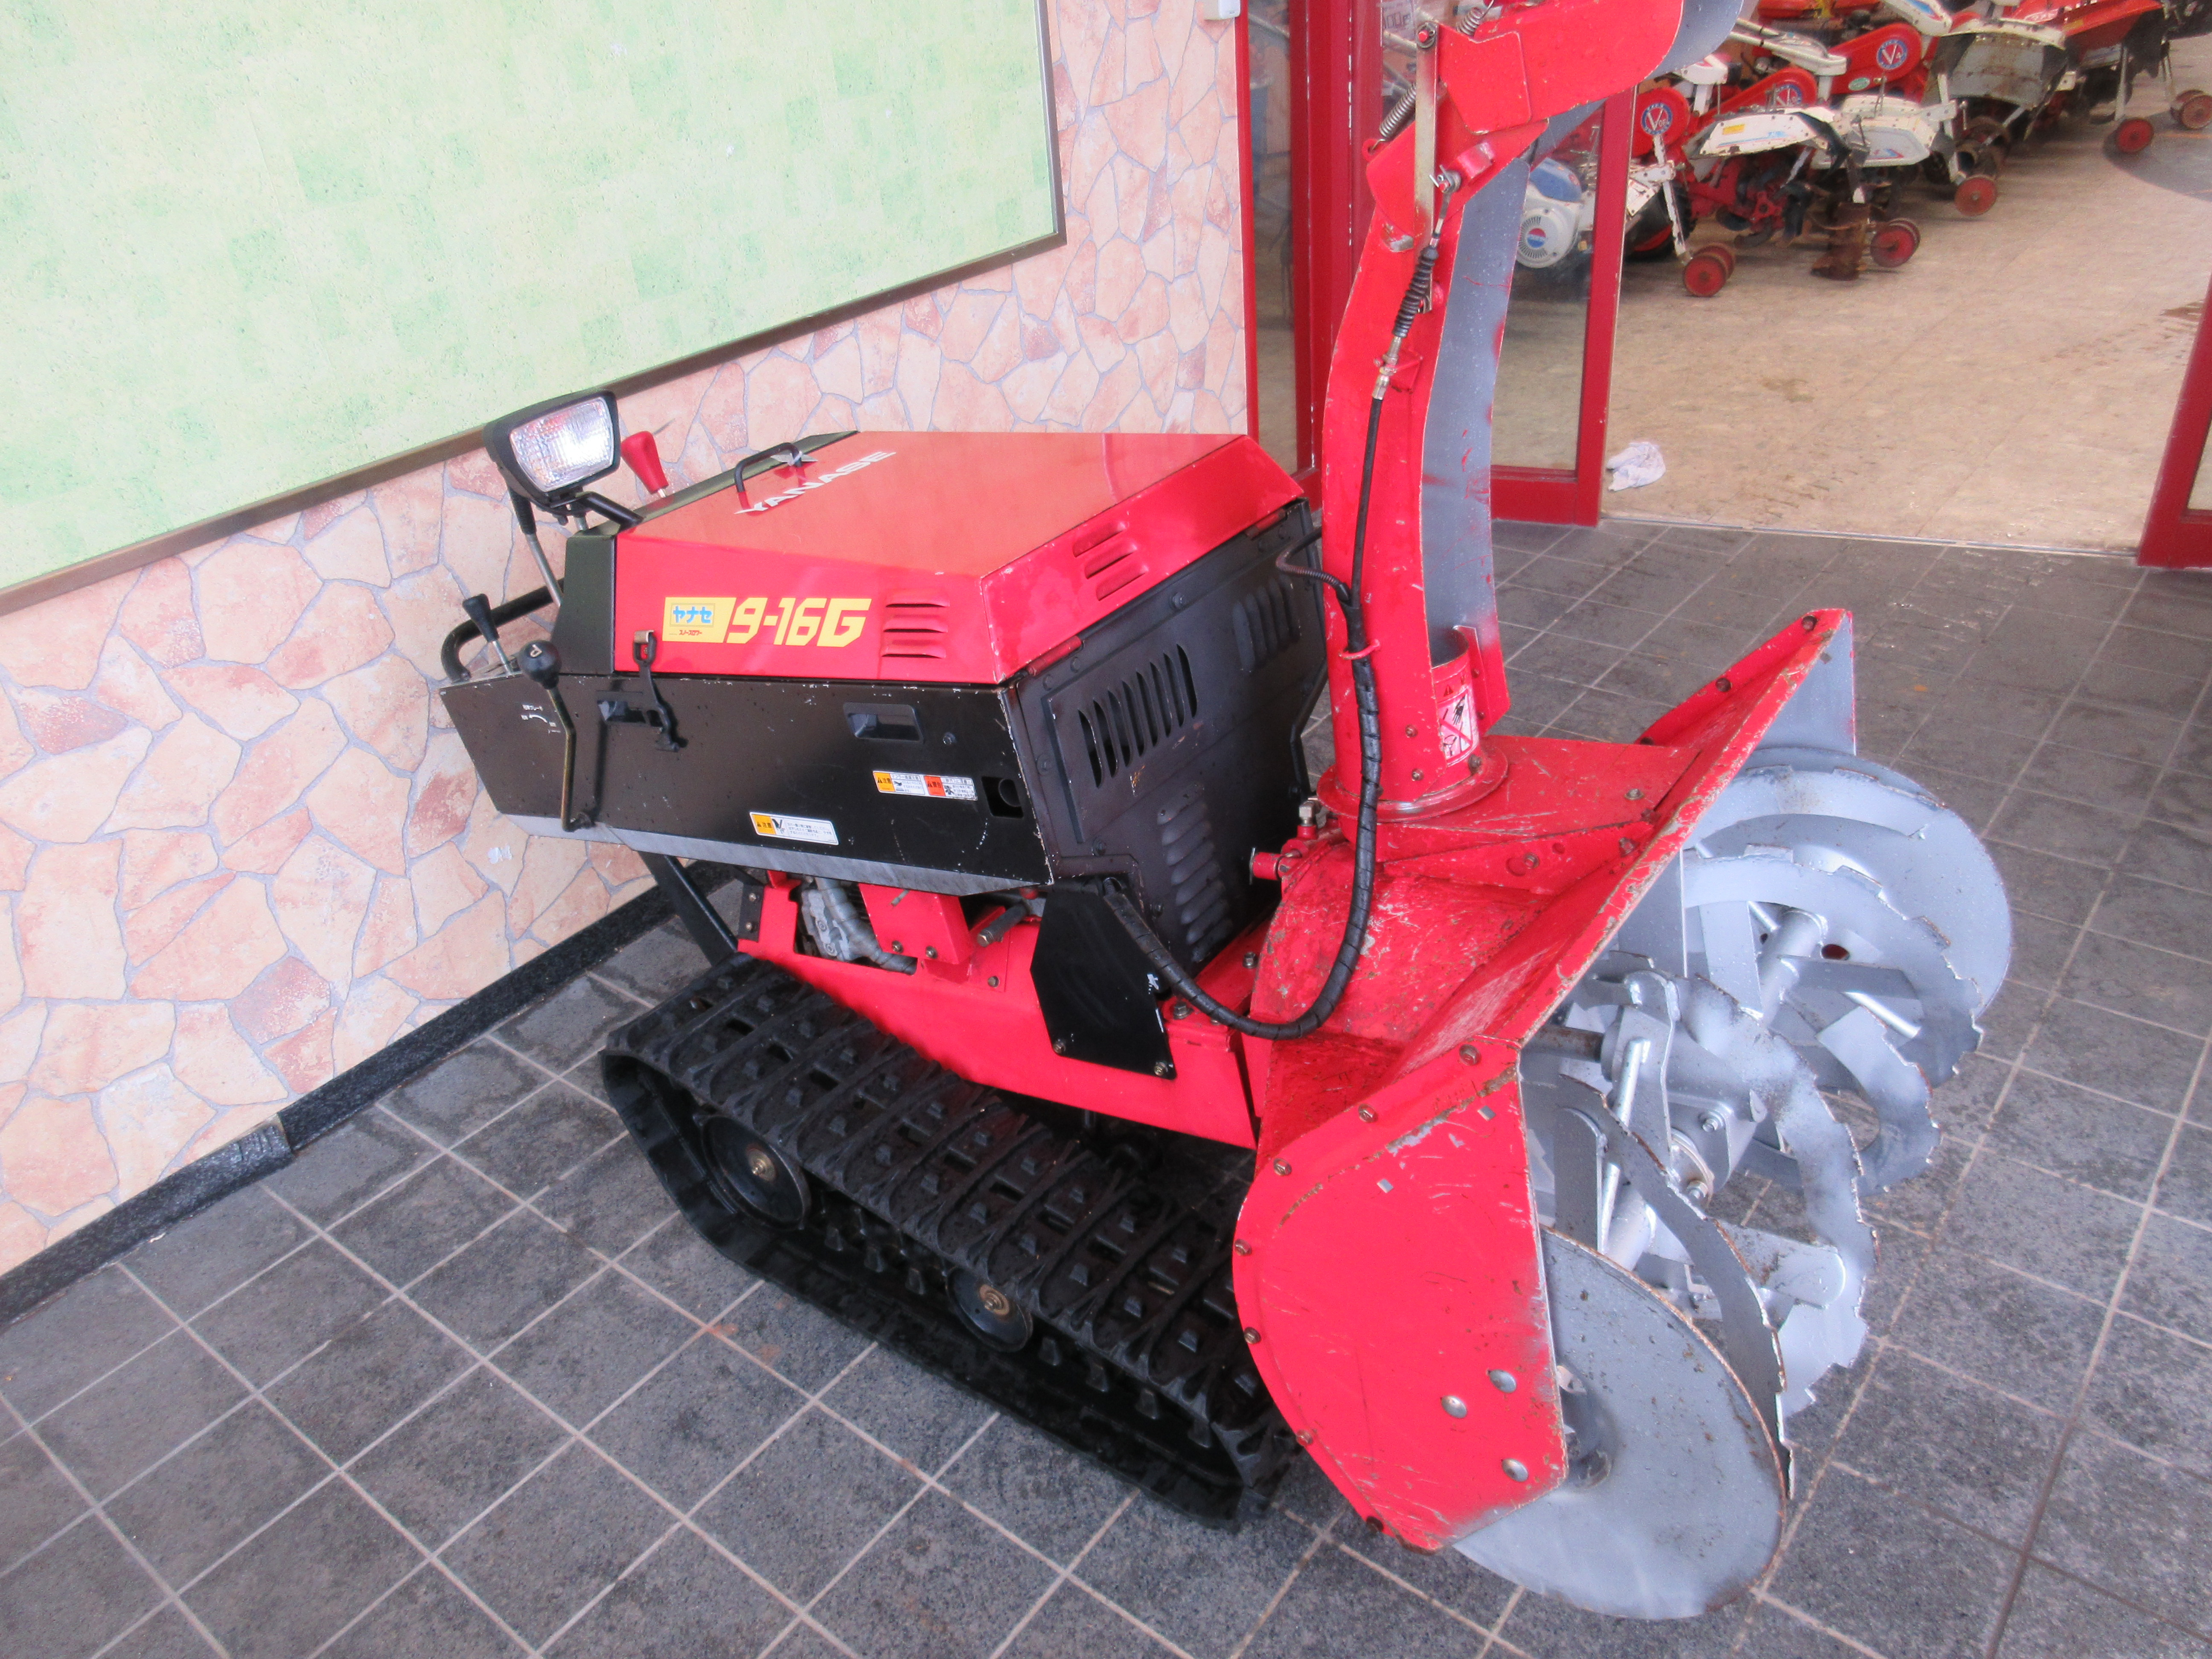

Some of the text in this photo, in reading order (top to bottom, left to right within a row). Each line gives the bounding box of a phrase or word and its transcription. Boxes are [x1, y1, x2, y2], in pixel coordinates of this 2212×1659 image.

[734, 451, 896, 514] YANASE
[672, 605, 713, 624] ヤナセ
[726, 597, 872, 647] 9-16G
[530, 644, 542, 658] P
